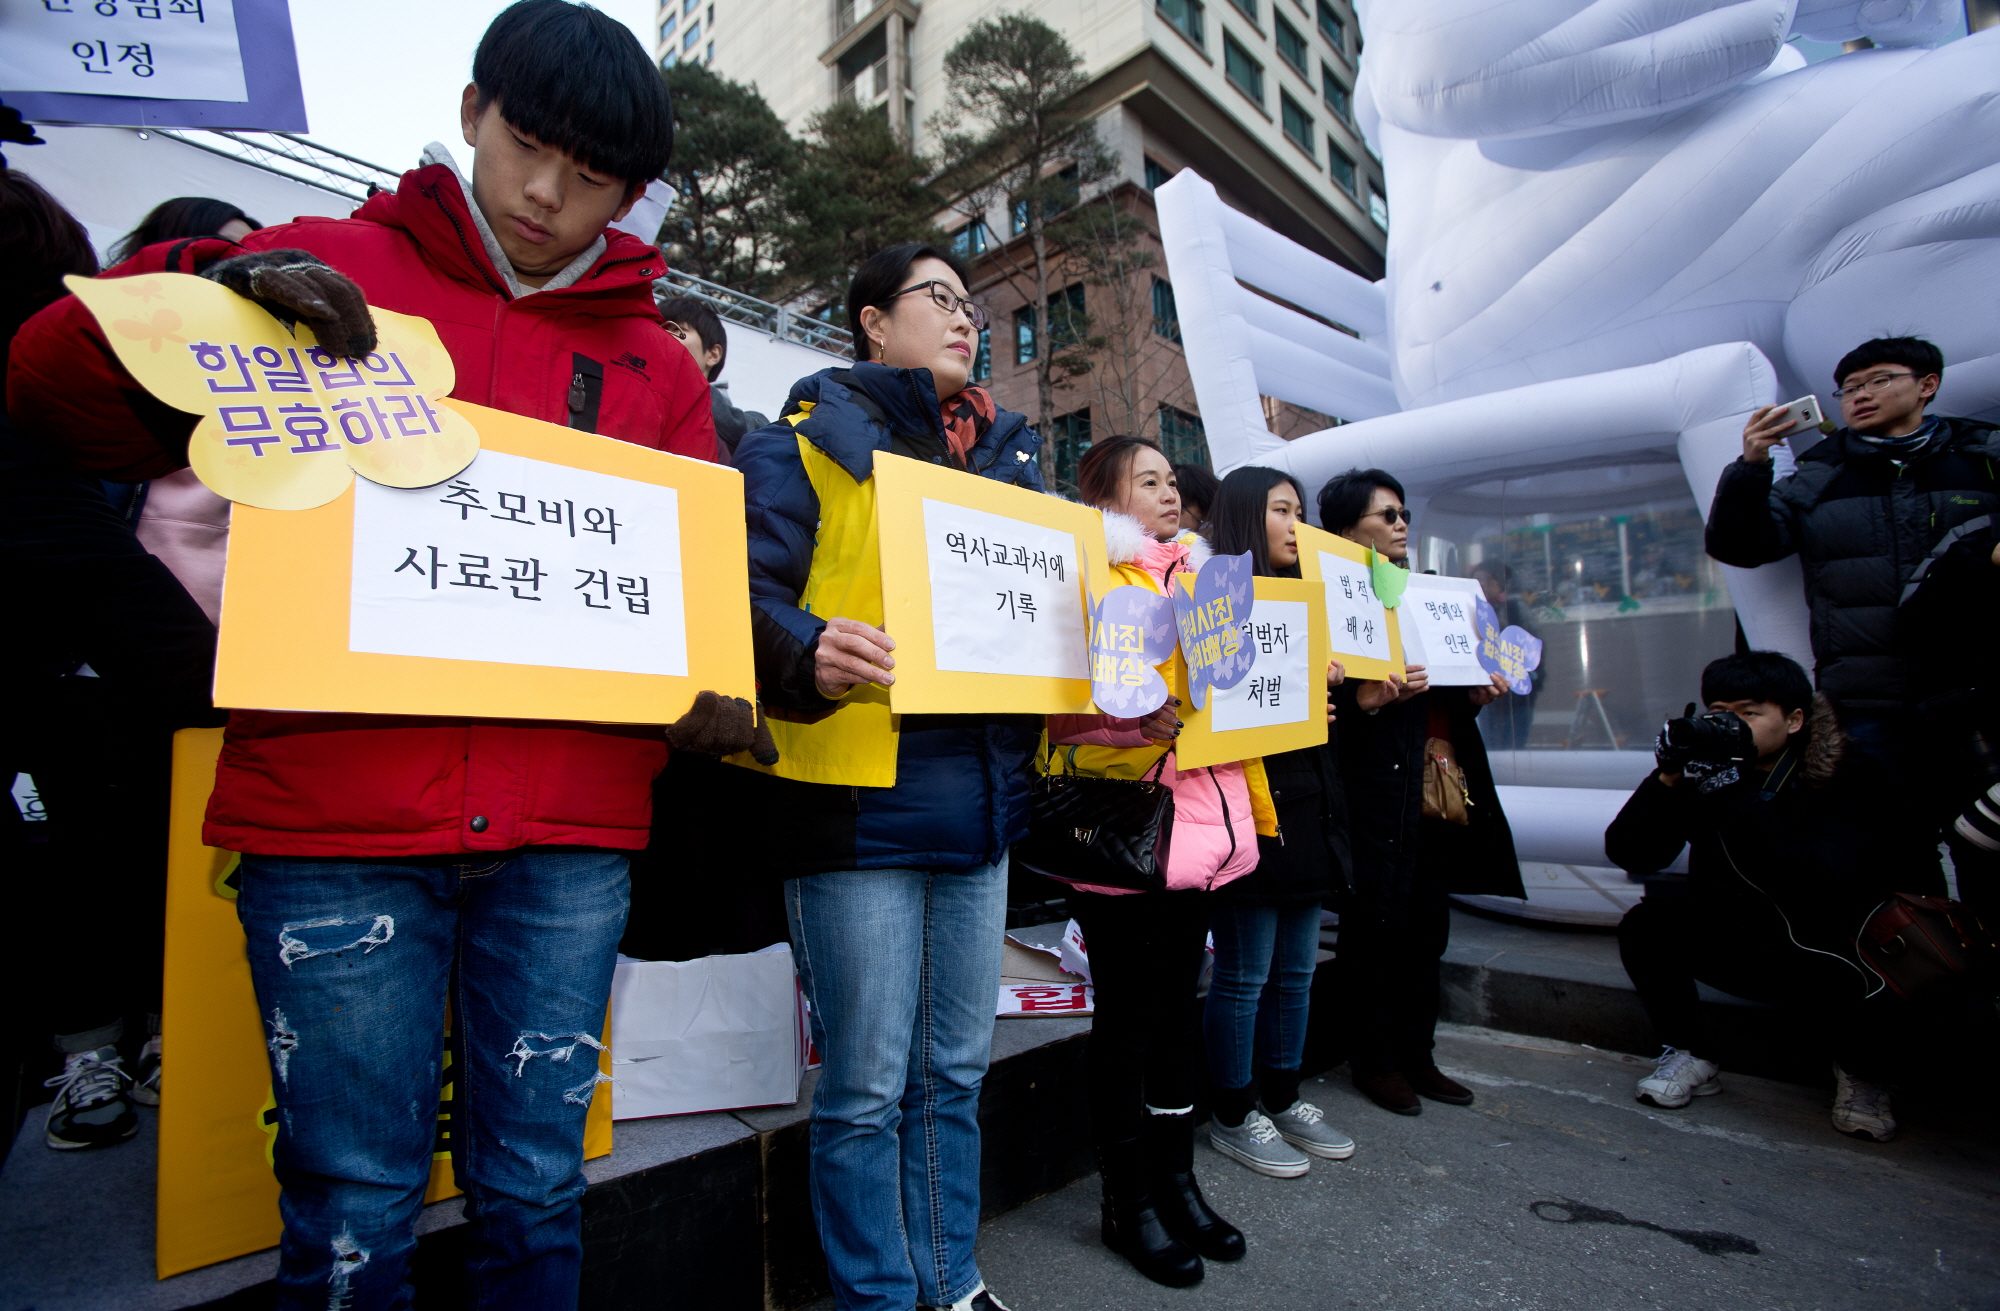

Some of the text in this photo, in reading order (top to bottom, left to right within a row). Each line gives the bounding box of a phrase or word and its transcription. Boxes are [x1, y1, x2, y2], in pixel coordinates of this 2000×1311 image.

[71, 39, 155, 78] 인정
[187, 340, 417, 394] 한일합의
[216, 393, 443, 458] 무효하라
[439, 479, 622, 545] 추모비와
[946, 532, 1065, 583] 역사교과서에
[394, 544, 650, 615] 사료관 건립
[996, 589, 1037, 623] 기록
[1425, 601, 1465, 621] 명예와
[1088, 615, 1145, 654] 사죄
[1444, 633, 1472, 655] 인권
[1090, 649, 1147, 687] 배상
[1247, 675, 1282, 709] 처벌
